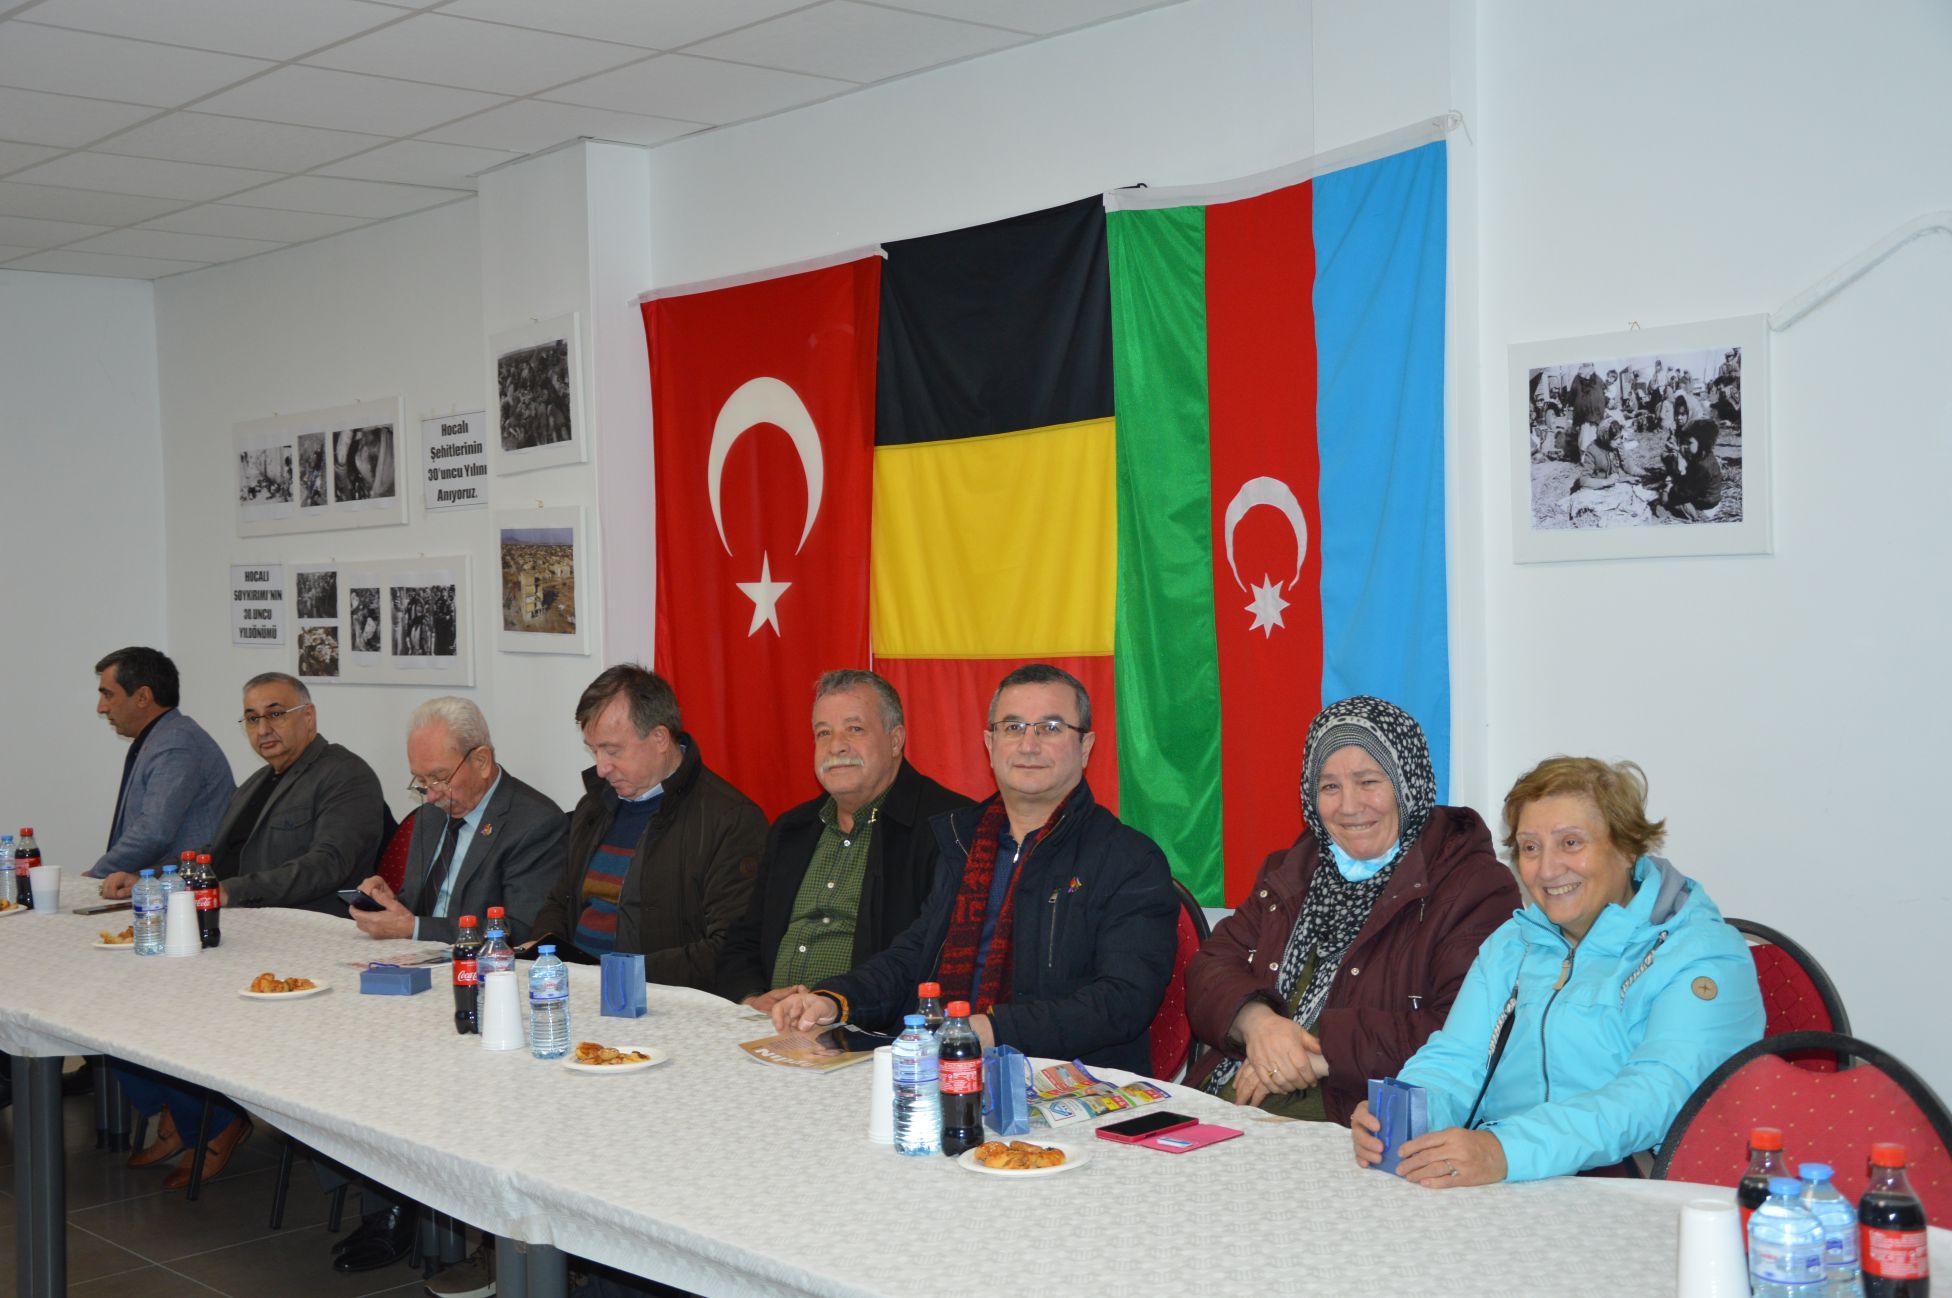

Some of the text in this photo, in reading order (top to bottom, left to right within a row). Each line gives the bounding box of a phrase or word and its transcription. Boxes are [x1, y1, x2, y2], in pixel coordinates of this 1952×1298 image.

[441, 420, 469, 436] Hocalı
[430, 441, 483, 462] Şehitlerinin
[428, 467, 463, 481] 30'uncu
[437, 488, 478, 503] Anıyoruz.
[244, 570, 269, 582] HOCALI
